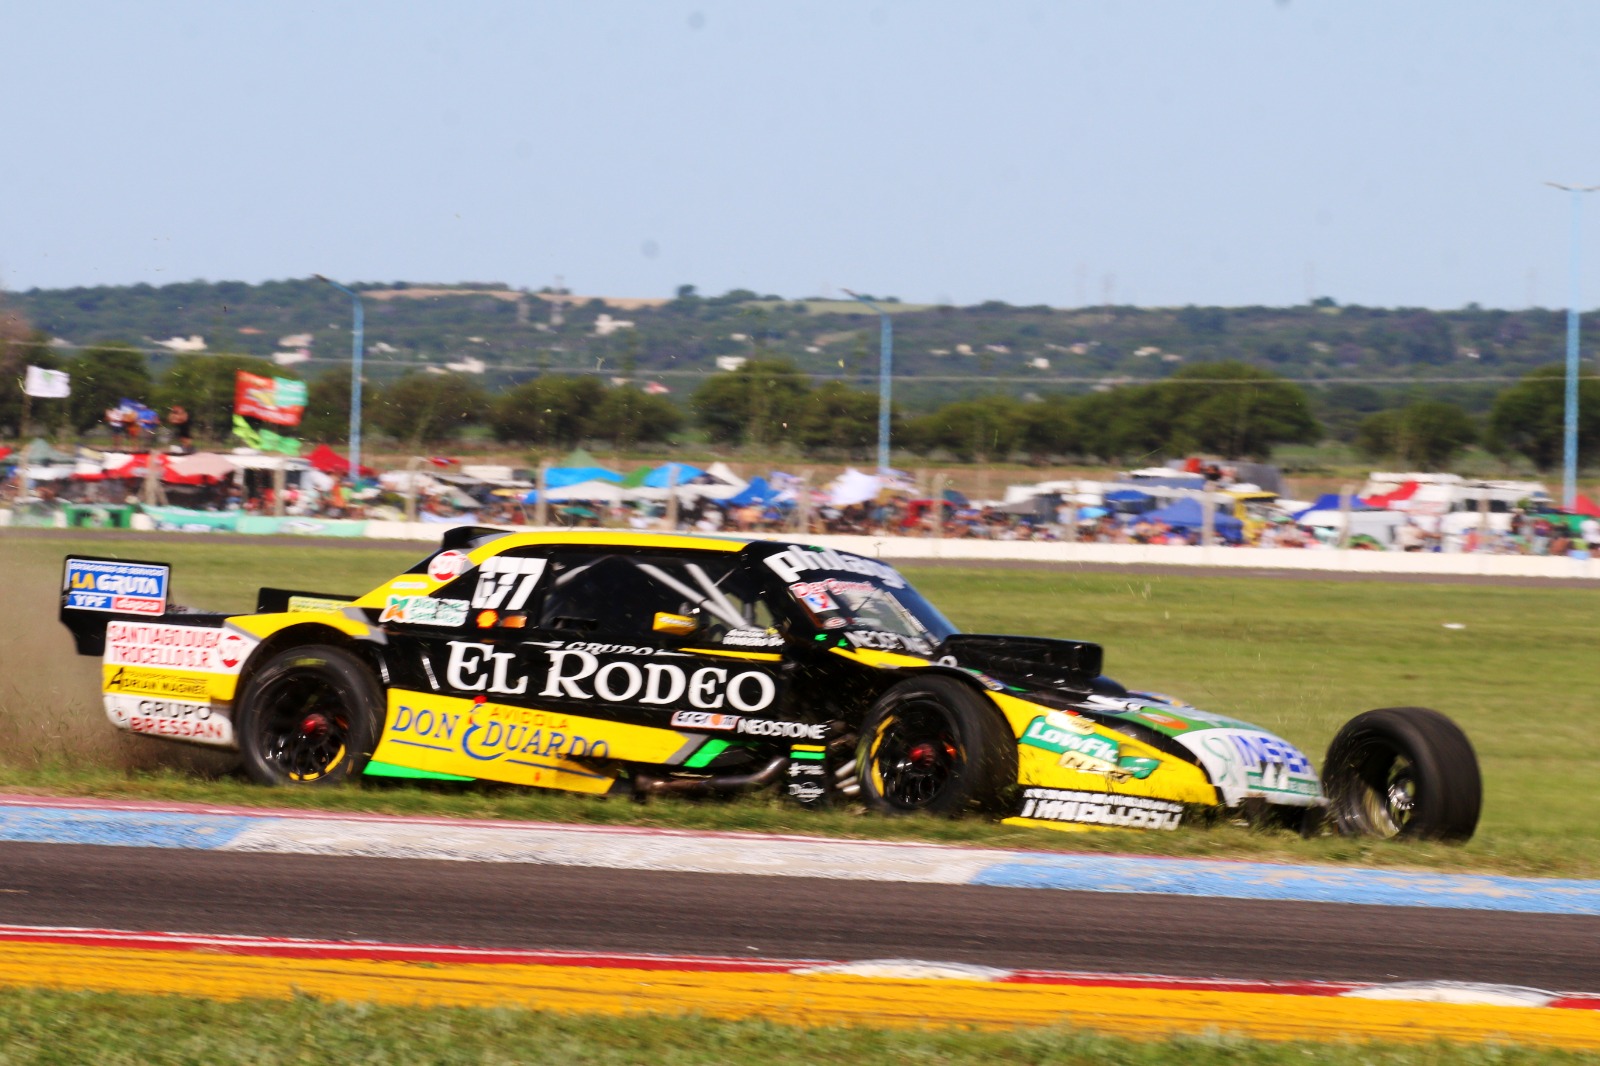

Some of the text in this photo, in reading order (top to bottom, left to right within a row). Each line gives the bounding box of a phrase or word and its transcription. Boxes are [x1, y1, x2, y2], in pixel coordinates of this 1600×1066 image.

[71, 572, 159, 595] LA GRUTA
[74, 594, 107, 607] YPF
[109, 624, 181, 646] SANTIAGO
[112, 644, 183, 666] TROCELLO
[565, 641, 654, 656] GRUPO
[537, 649, 776, 712] RODEO
[138, 700, 213, 721] GRUPO
[130, 716, 223, 739] BRESSAN
[391, 703, 610, 760] DON EDUARDO
[737, 718, 828, 739] NEOSTONE
